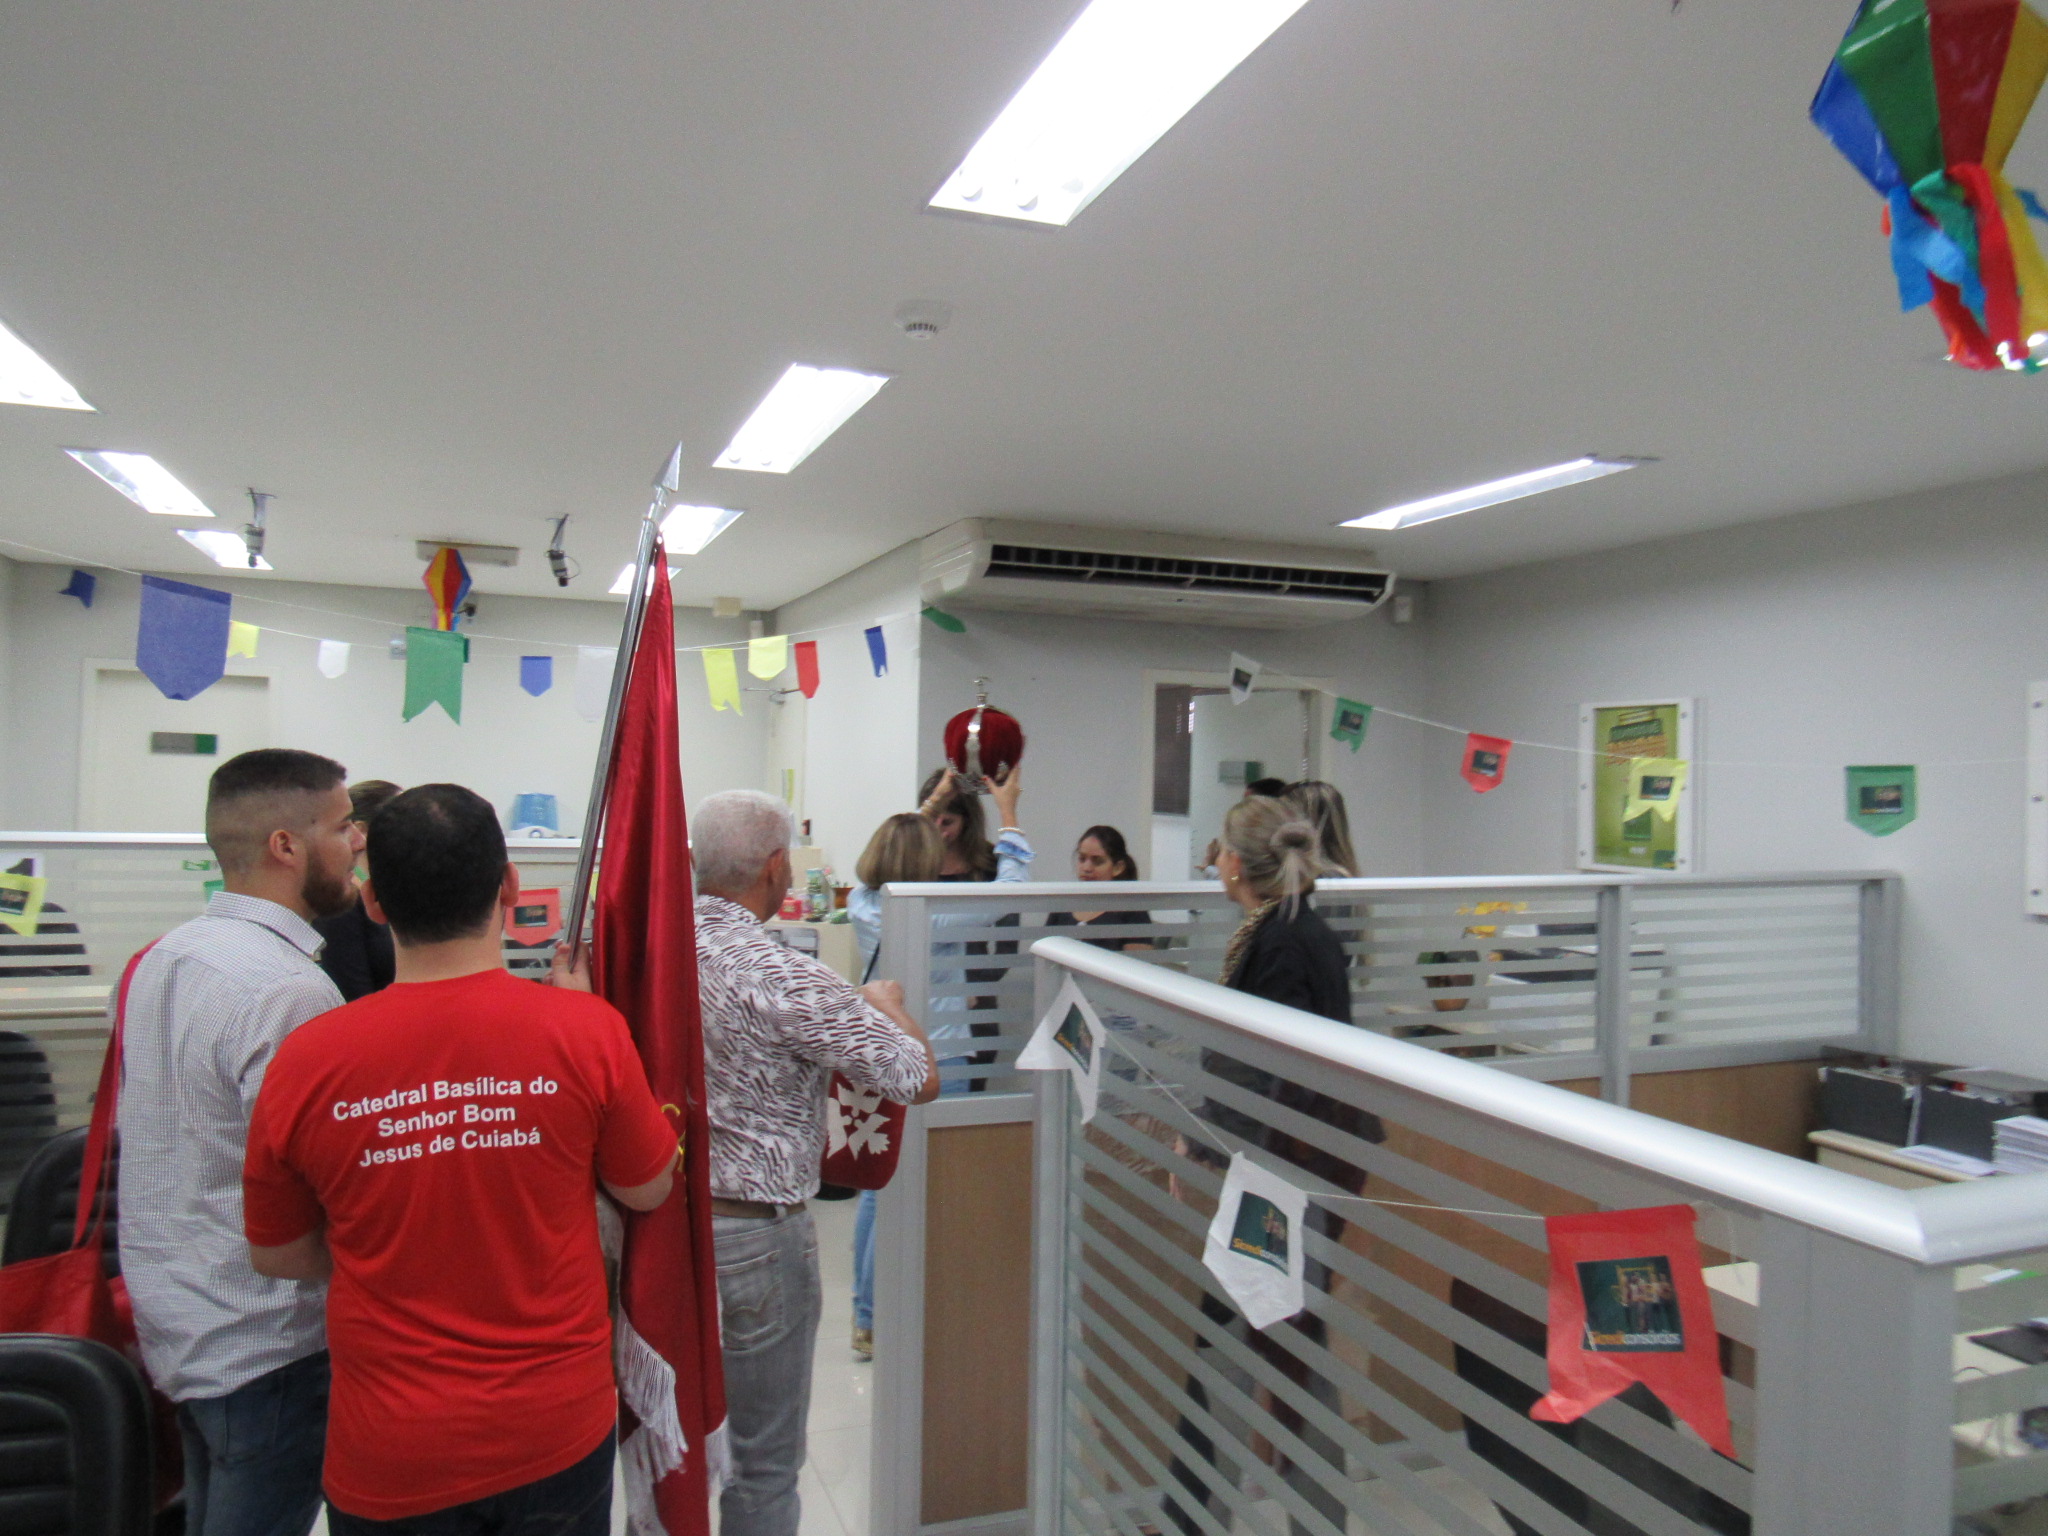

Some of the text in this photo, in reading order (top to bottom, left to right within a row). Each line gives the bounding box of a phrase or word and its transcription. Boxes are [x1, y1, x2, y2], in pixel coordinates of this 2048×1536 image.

[333, 1076, 558, 1121] Catedral Basílica do
[378, 1104, 516, 1137] Senhor Bom
[359, 1127, 541, 1167] Jesus de Cuiabá
